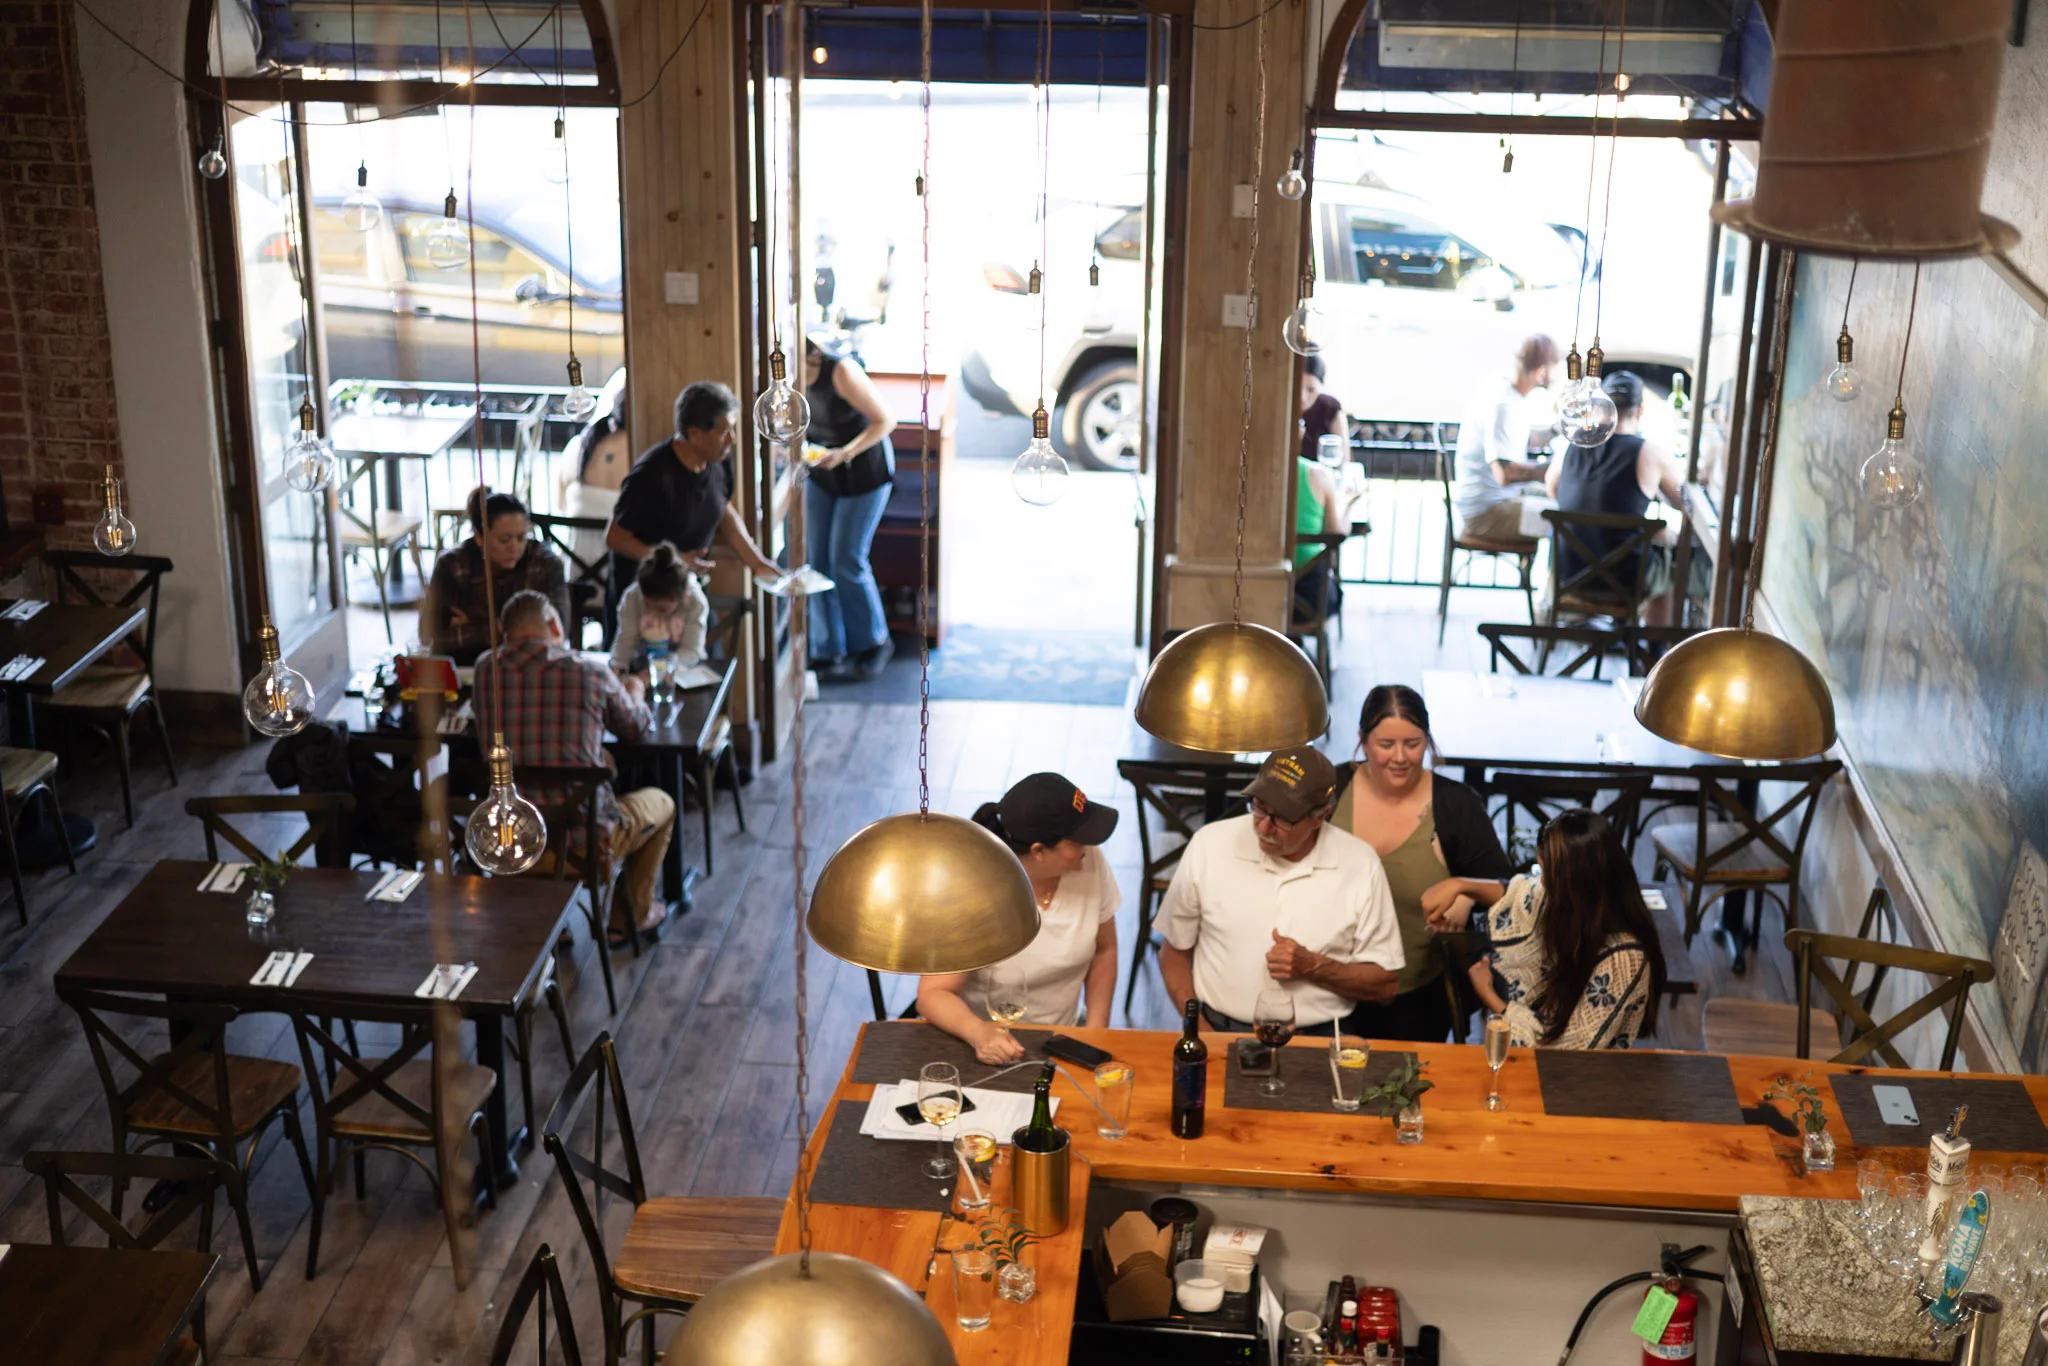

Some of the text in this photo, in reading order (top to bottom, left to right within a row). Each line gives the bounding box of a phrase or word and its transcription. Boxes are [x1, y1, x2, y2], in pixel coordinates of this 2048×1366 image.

[1950, 1223, 1972, 1268] KONA
[1960, 1227, 1982, 1272] BIG WAVE
